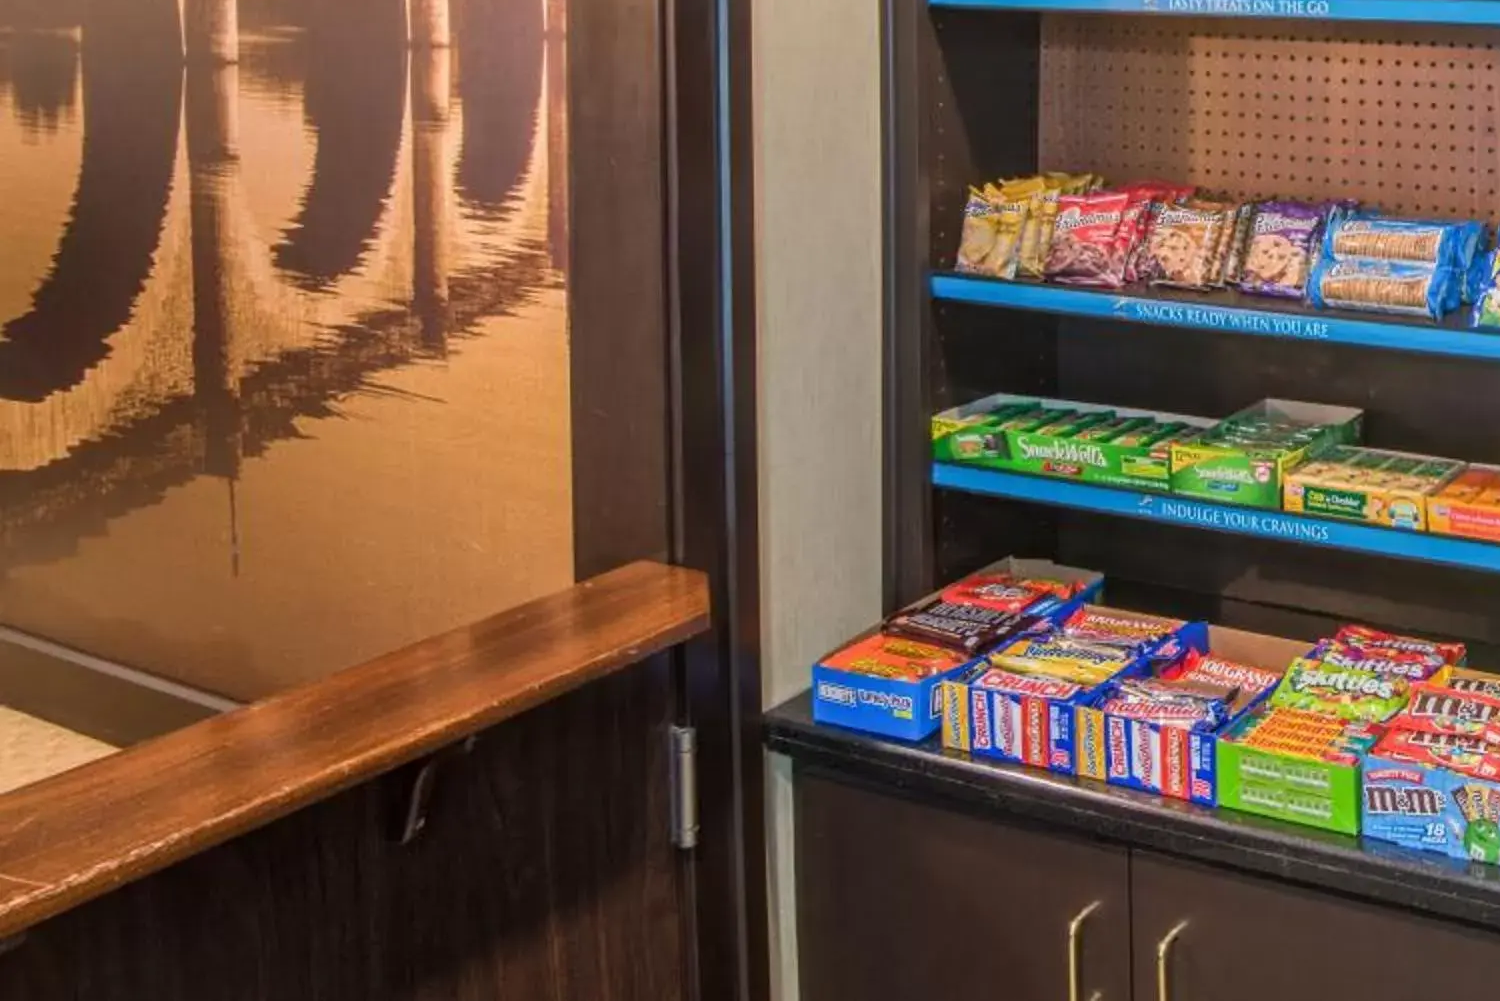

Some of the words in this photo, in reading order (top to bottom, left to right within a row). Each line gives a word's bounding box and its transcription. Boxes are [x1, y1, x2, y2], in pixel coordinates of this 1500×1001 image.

[1254, 0, 1275, 13] ON
[1279, 0, 1304, 14] THE
[1307, 0, 1330, 14] GO
[1136, 304, 1185, 321] SNACKS
[1187, 308, 1226, 327] READY
[1229, 311, 1269, 330] WHEN
[1271, 318, 1303, 335] YOU
[1305, 323, 1329, 339] ARE
[1162, 502, 1221, 525] INDULGE
[1223, 509, 1260, 531] YOUR
[1262, 516, 1329, 541] CRAVINGS
[980, 670, 1082, 699] CRUNCH
[972, 691, 991, 749] CRUNCH
[1110, 719, 1127, 776] CRUNCH
[1426, 822, 1446, 836] 18
